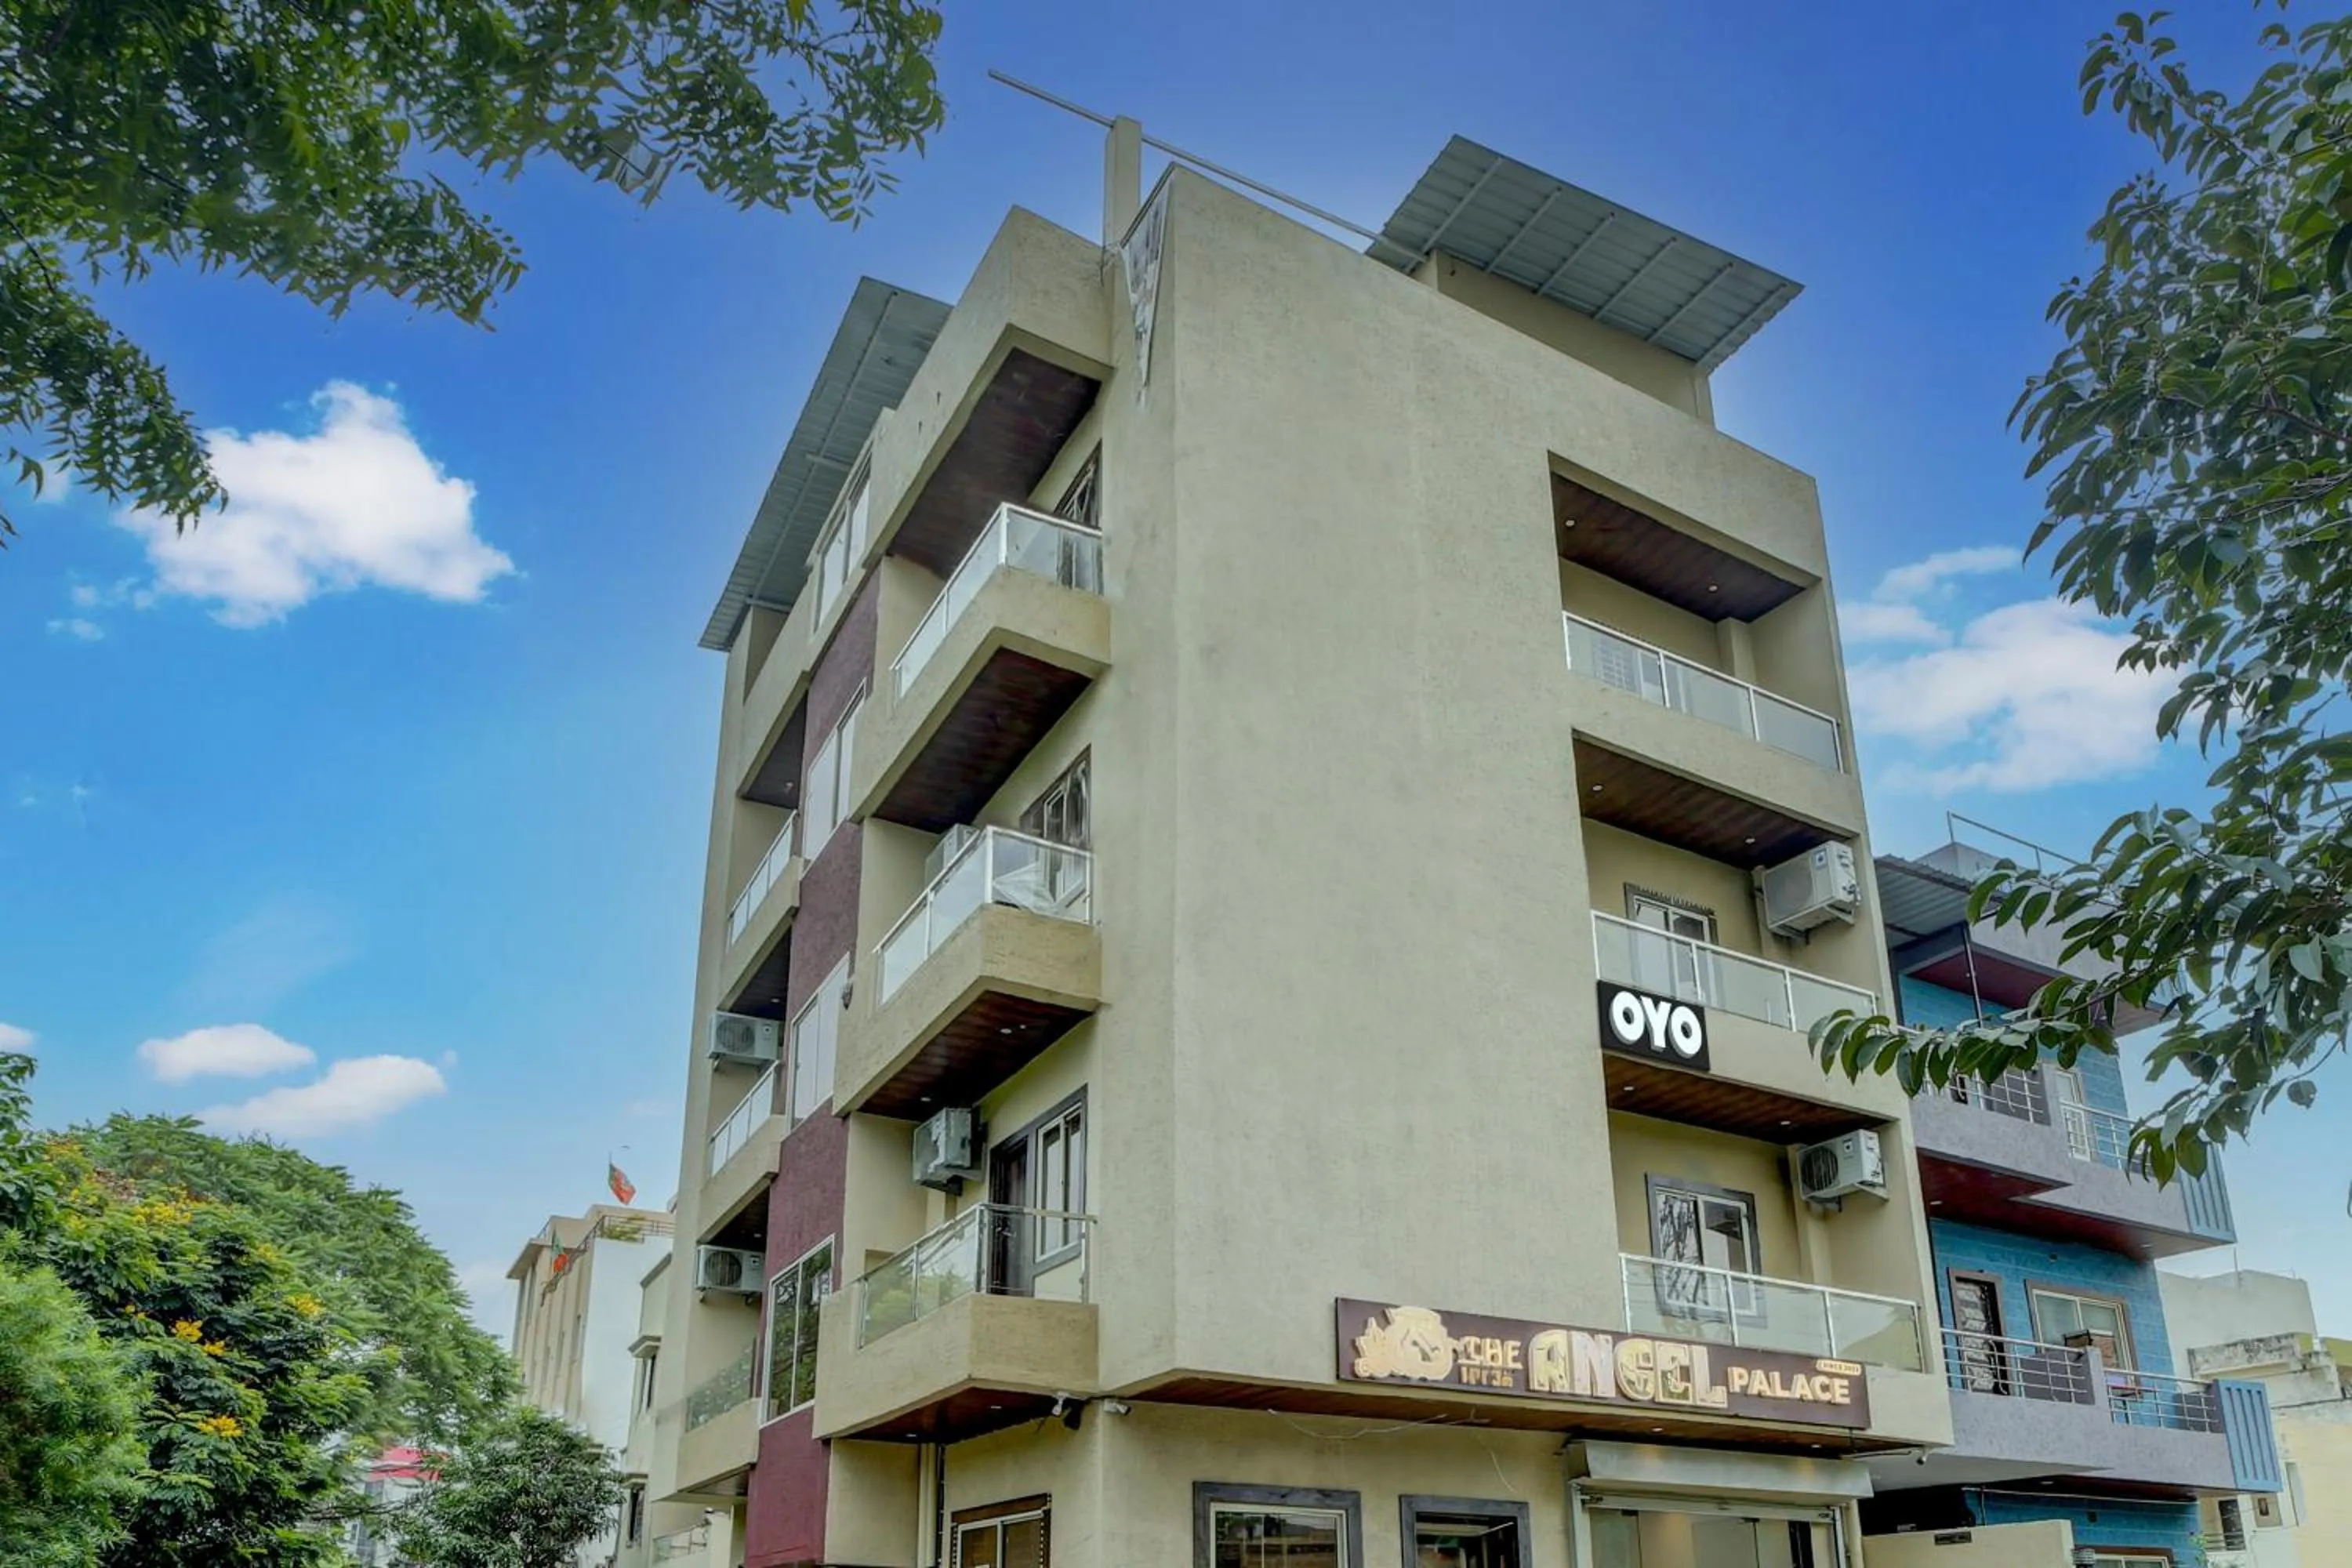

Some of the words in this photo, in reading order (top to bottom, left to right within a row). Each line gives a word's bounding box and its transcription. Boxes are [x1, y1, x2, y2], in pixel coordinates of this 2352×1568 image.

[1610, 990, 1702, 1058] OYO
[1458, 1336, 1523, 1370] THE
[1528, 1329, 1728, 1408] ANGEL
[1727, 1367, 1851, 1404] PALACE
